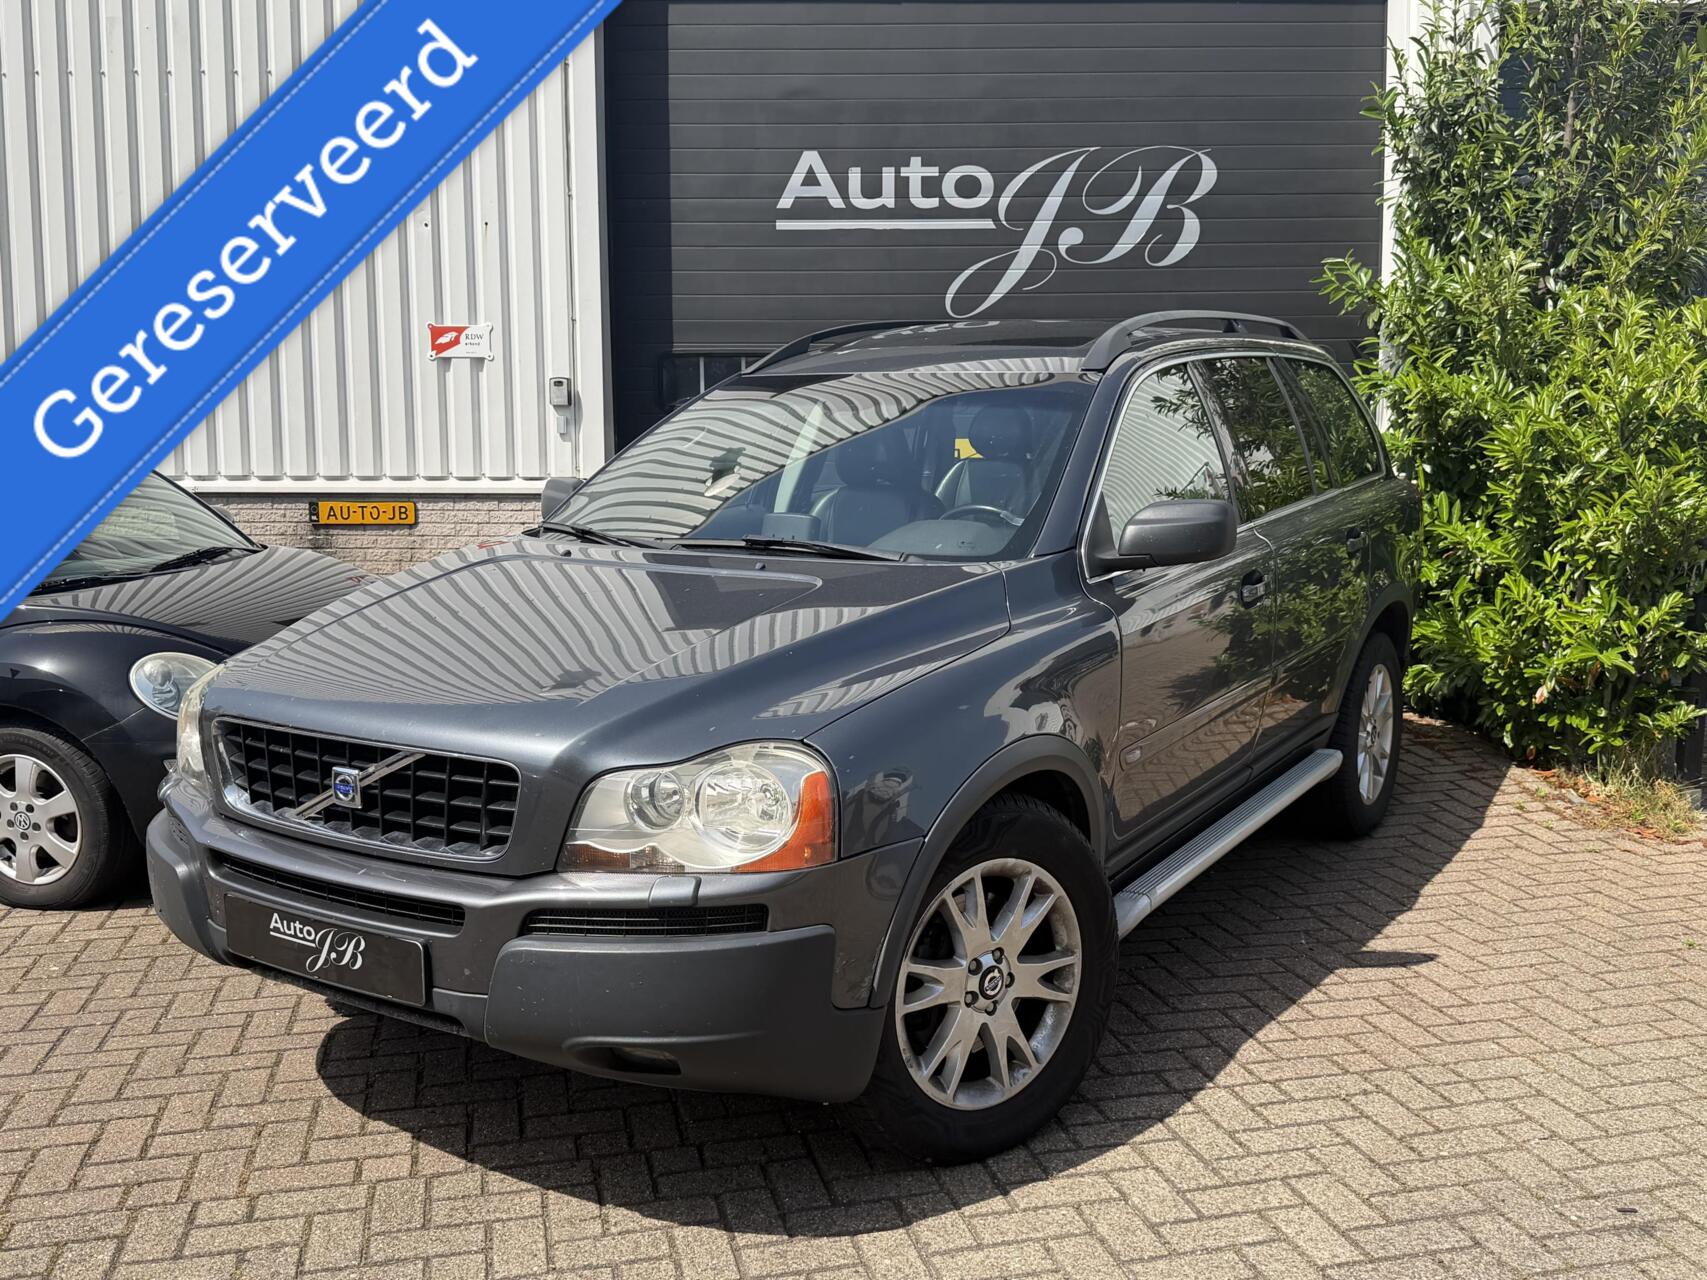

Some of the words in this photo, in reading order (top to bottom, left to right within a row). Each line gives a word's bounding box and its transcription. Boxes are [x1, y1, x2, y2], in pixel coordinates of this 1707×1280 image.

[776, 150, 995, 210] Auto
[944, 145, 1218, 319] JB
[326, 505, 409, 521] AU-TO-JB
[269, 912, 316, 941] Auto
[305, 927, 366, 973] JB
